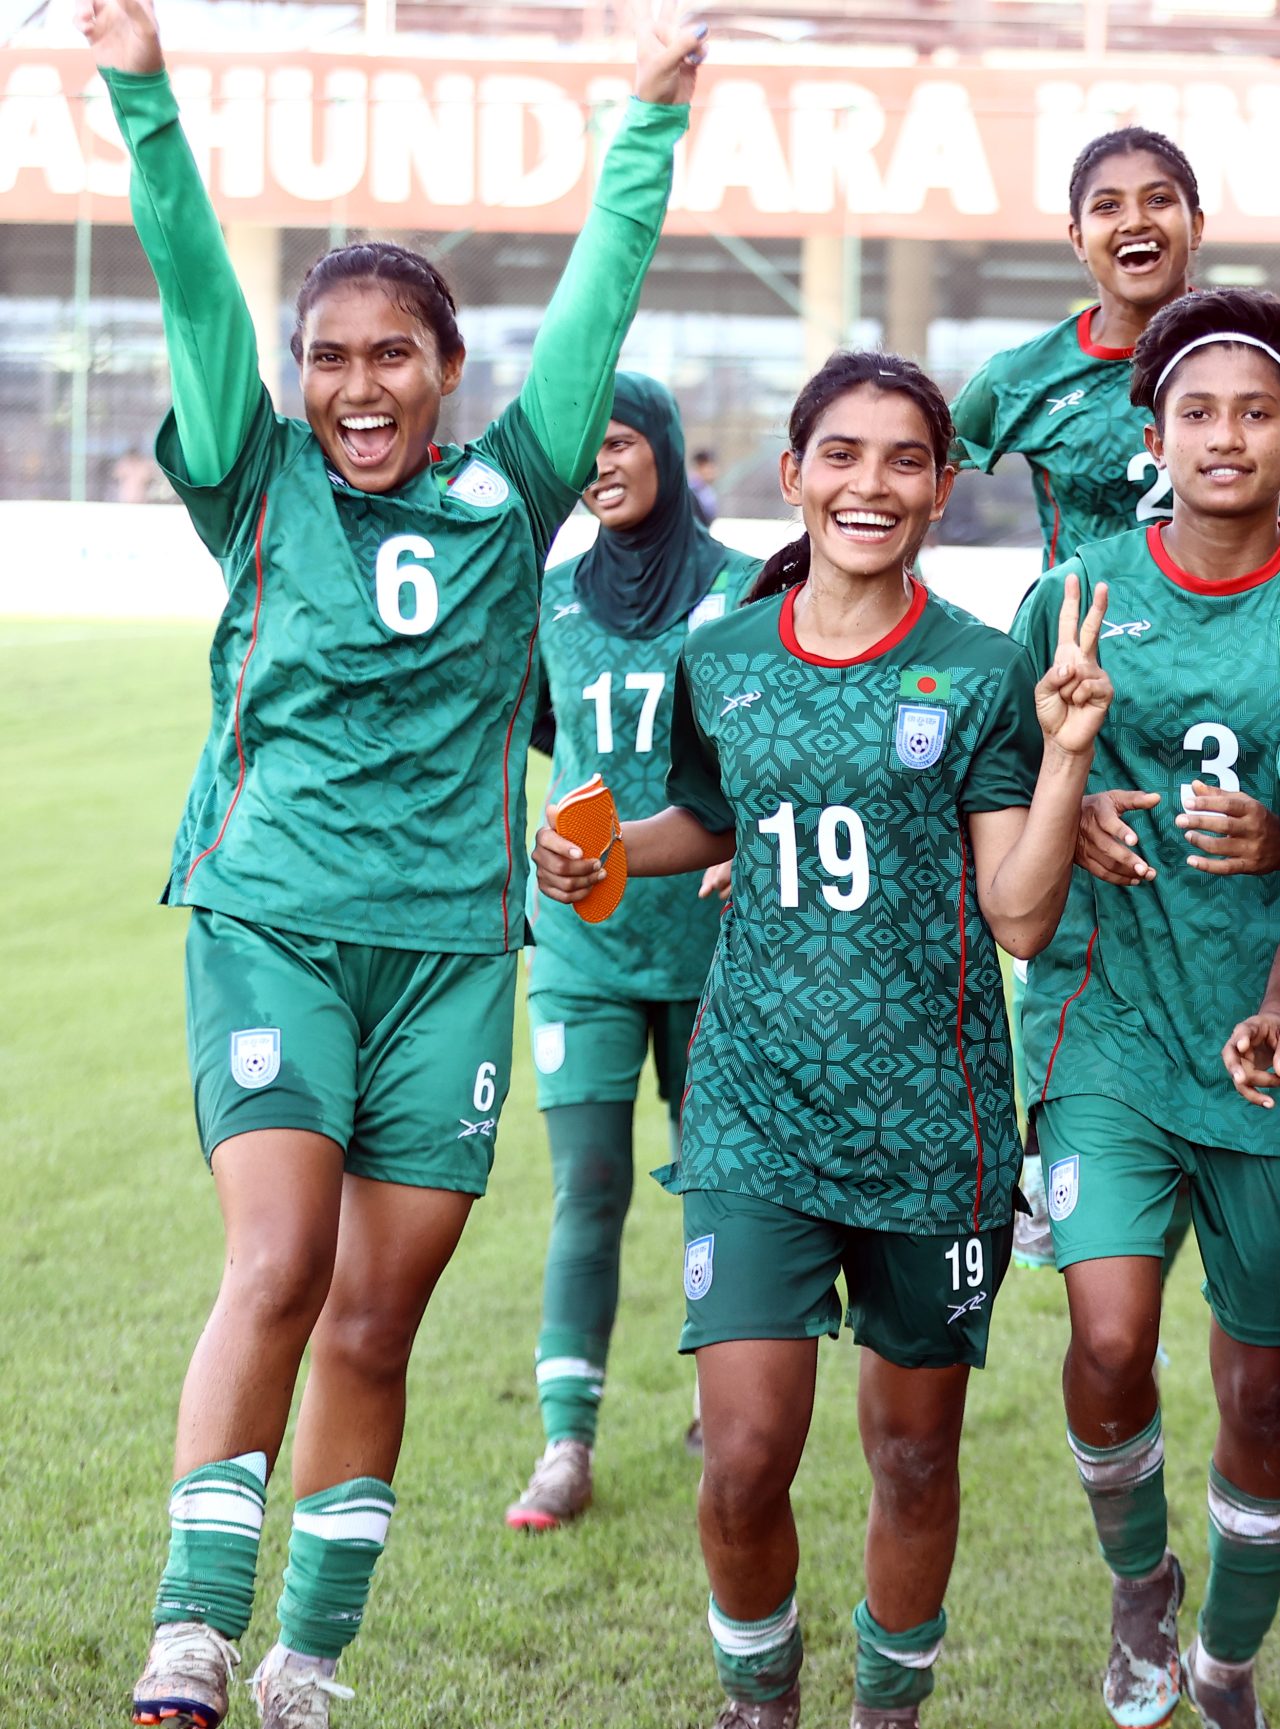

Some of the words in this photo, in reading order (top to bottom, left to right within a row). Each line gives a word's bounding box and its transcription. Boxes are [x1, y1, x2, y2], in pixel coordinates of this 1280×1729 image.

[375, 534, 439, 636] 6
[582, 671, 666, 755] 17
[1180, 722, 1240, 818] 3
[758, 801, 870, 912] 19
[473, 1061, 497, 1112] 6
[945, 1238, 984, 1291] 19
